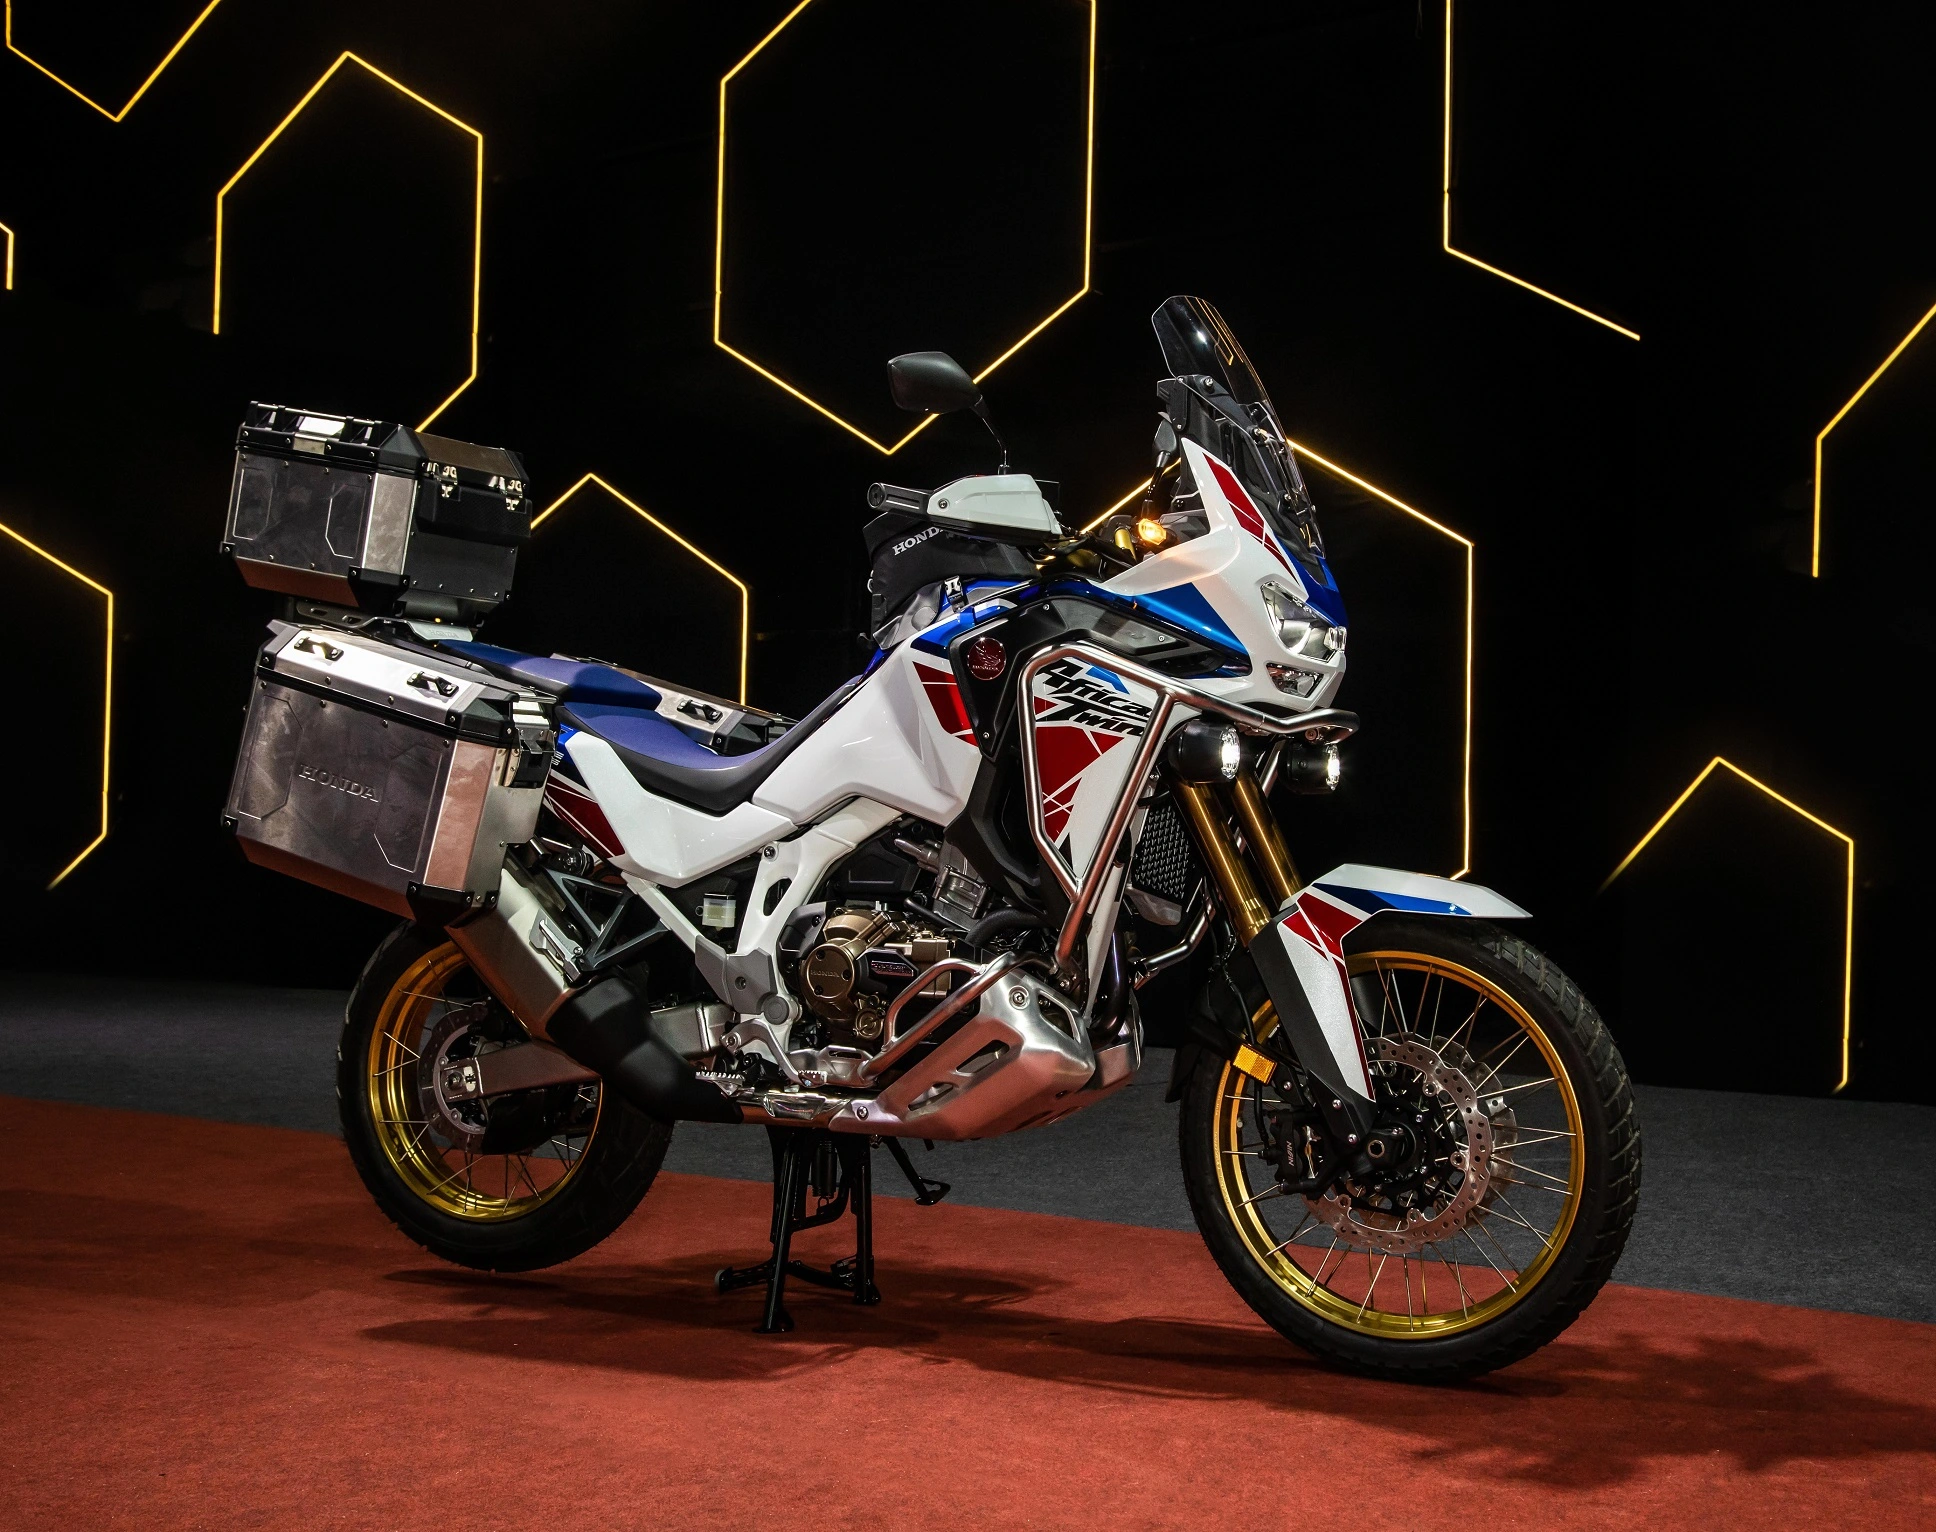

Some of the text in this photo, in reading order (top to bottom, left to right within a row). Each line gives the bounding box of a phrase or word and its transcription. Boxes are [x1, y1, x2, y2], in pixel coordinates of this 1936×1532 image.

[892, 526, 944, 556] HOND
[1035, 657, 1153, 718] Africa
[1036, 695, 1149, 737] Twin
[298, 763, 380, 803] HONDA
[810, 969, 840, 978] HONDA
